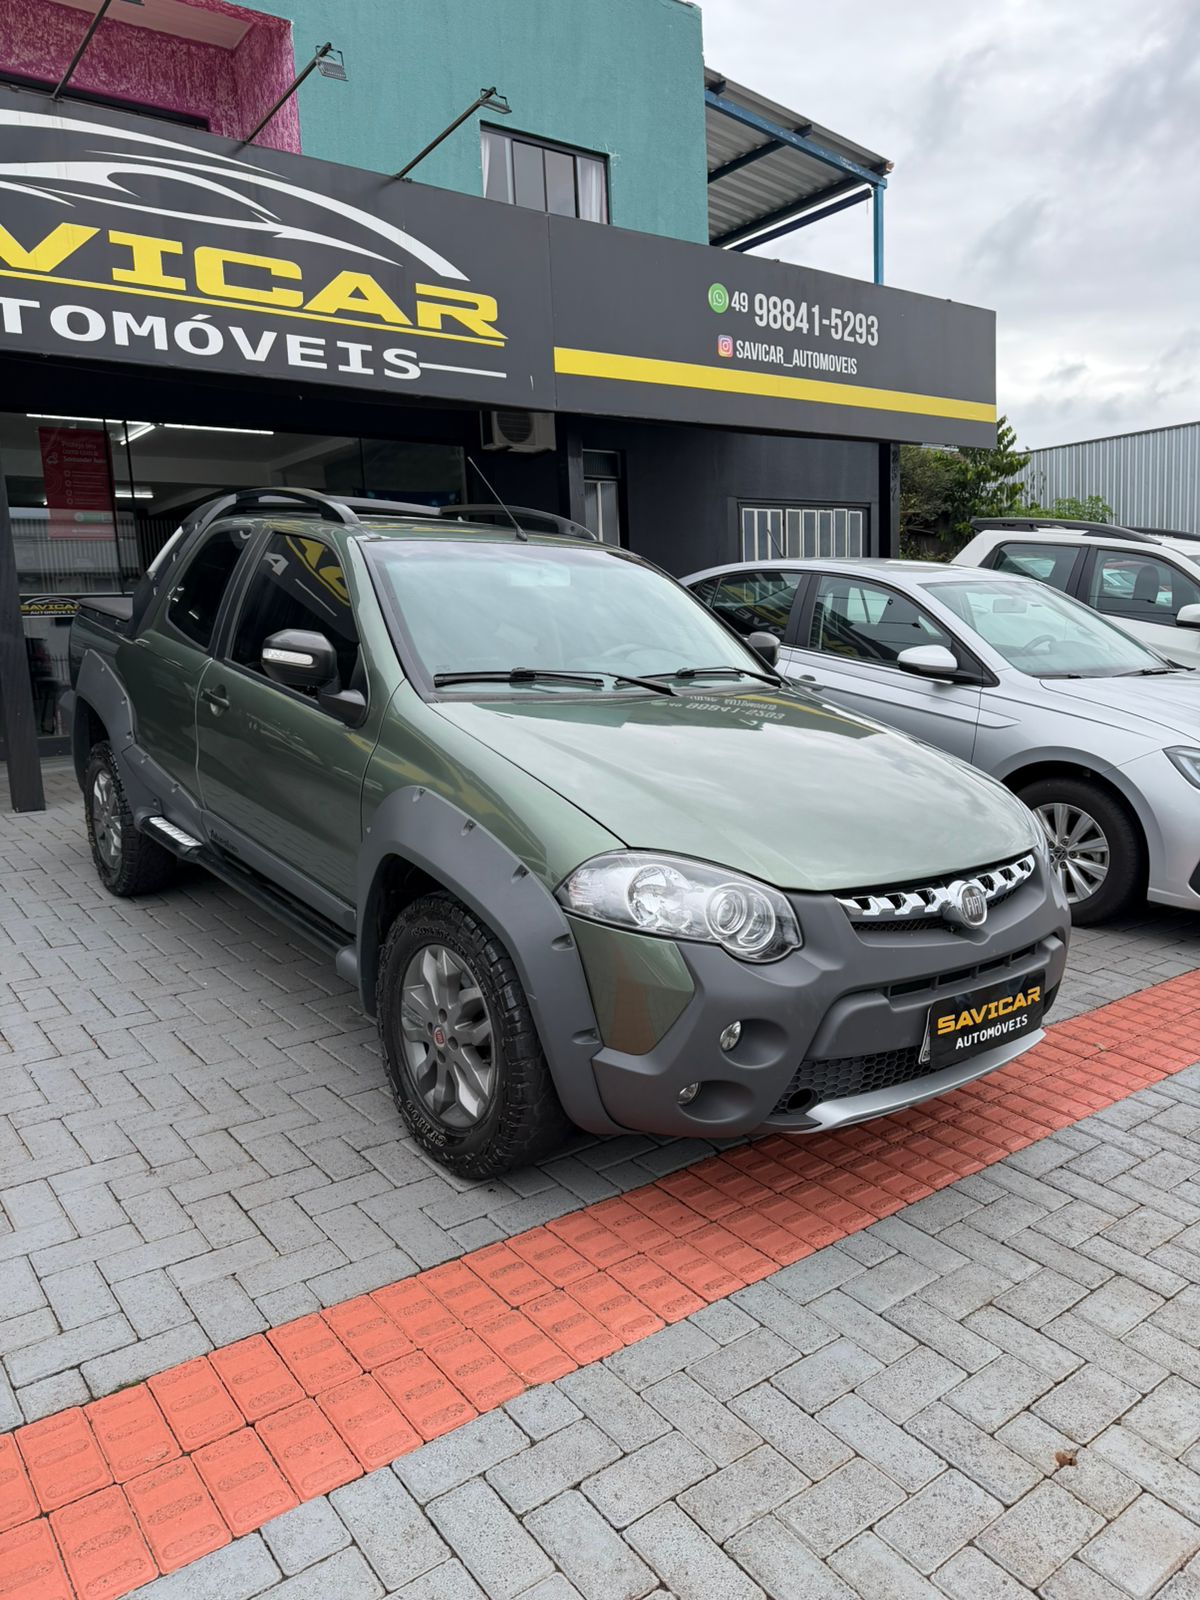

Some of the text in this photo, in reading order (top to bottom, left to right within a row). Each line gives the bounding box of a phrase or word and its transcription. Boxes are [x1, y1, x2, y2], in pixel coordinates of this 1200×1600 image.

[731, 291, 879, 347] 49 98841-5293
[736, 340, 857, 375] SAVICAR_AUTOMOVEIS
[966, 896, 983, 916] FIAT
[937, 986, 1041, 1035] SAVICAR
[955, 1014, 1028, 1050] AUTOMÓVEIS
